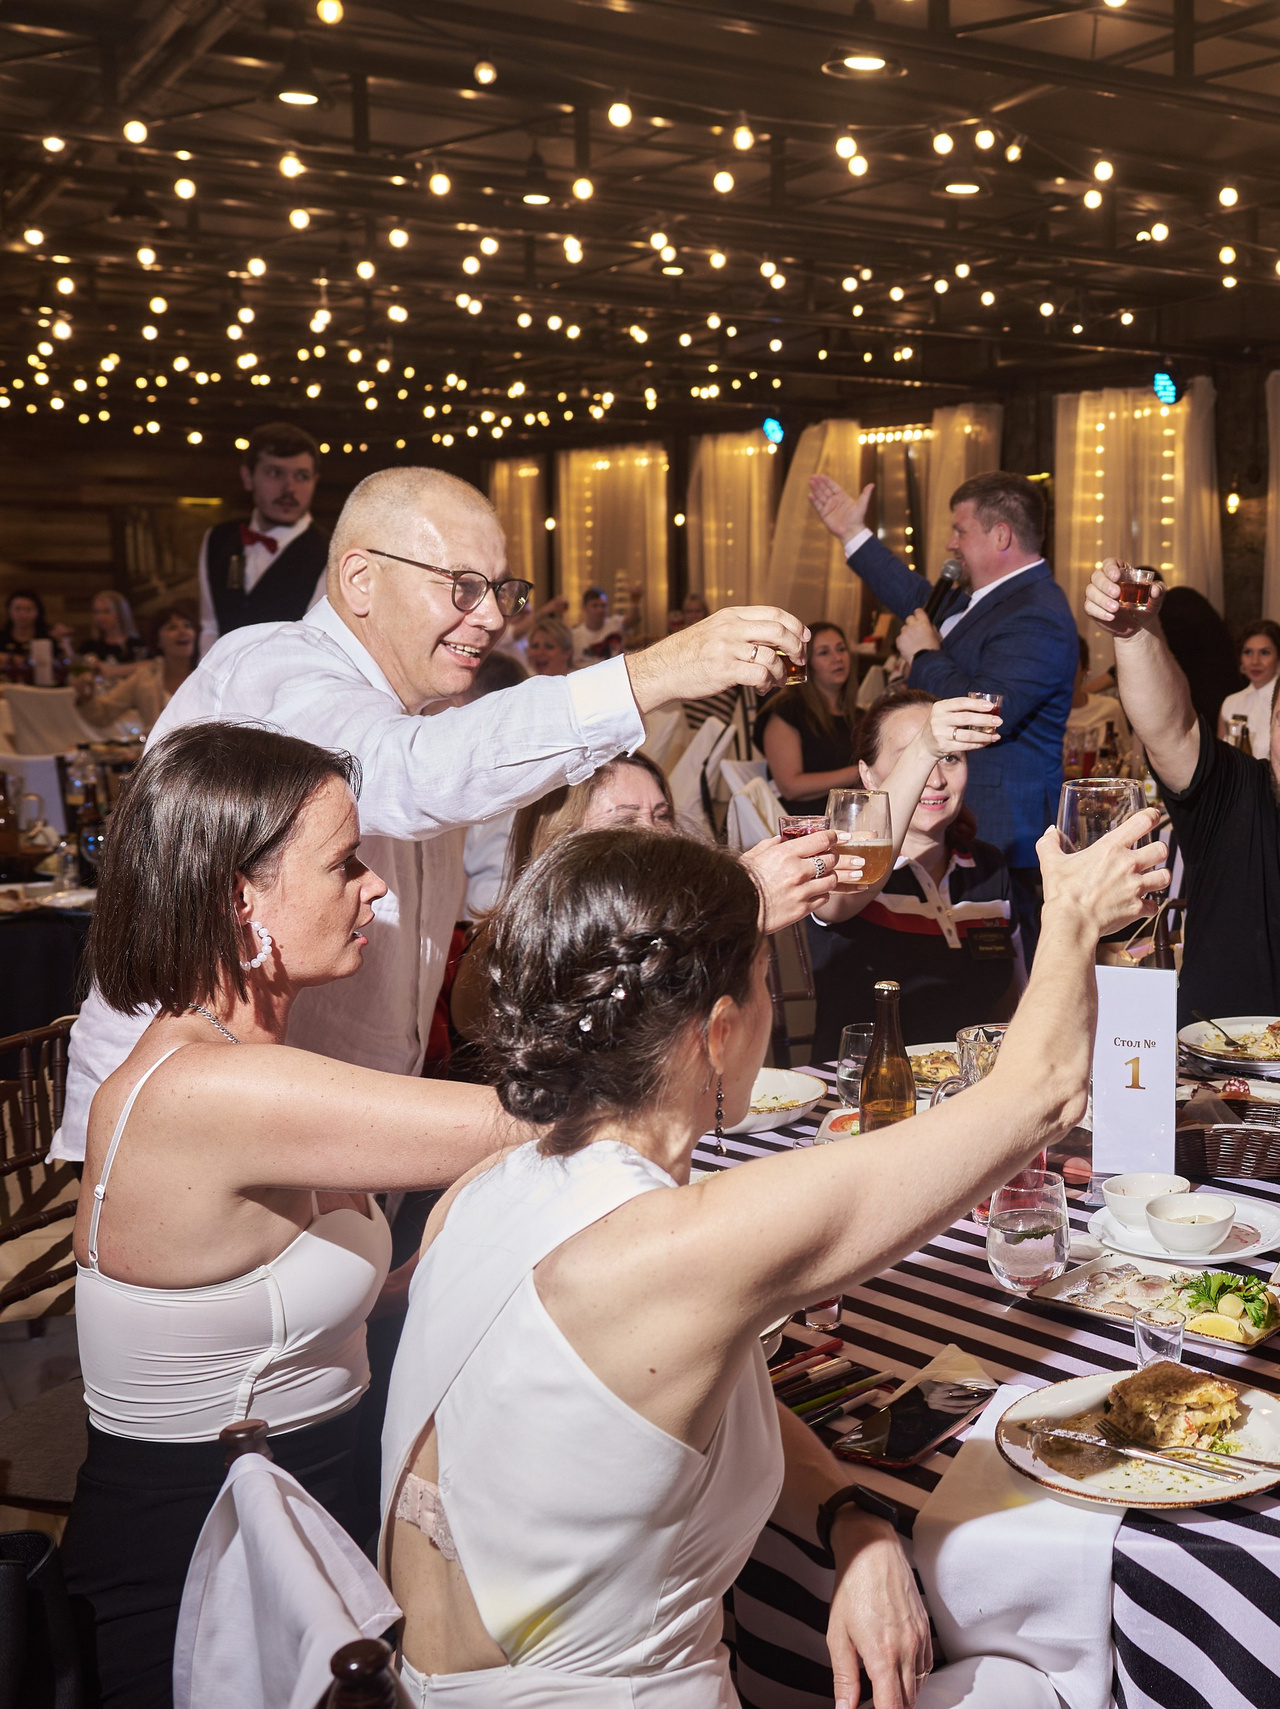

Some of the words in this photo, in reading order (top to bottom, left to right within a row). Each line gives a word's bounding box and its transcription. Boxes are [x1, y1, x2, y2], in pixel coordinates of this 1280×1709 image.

[1113, 1036, 1141, 1048] Стол
[1143, 1039, 1156, 1049] №
[1124, 1056, 1146, 1090] 1
